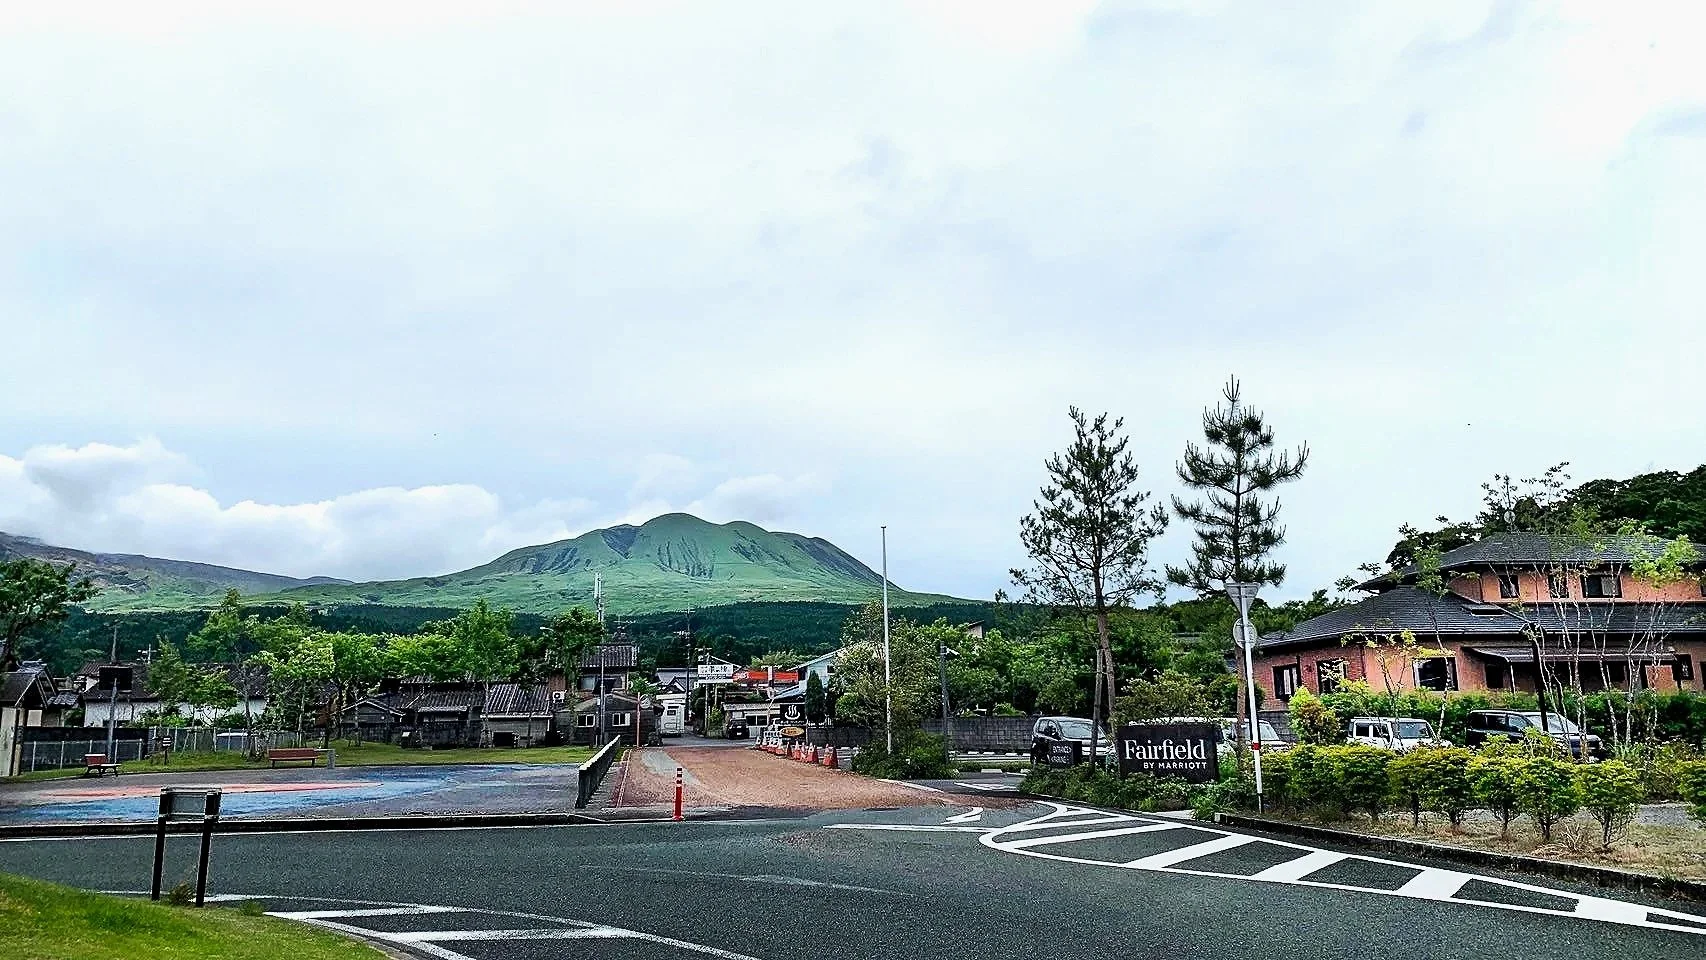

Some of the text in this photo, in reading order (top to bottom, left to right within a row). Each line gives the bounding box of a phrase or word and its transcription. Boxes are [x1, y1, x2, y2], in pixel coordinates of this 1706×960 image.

[1124, 739, 1207, 760] Fairfield
[1143, 761, 1207, 770] BY MARRIOTT
